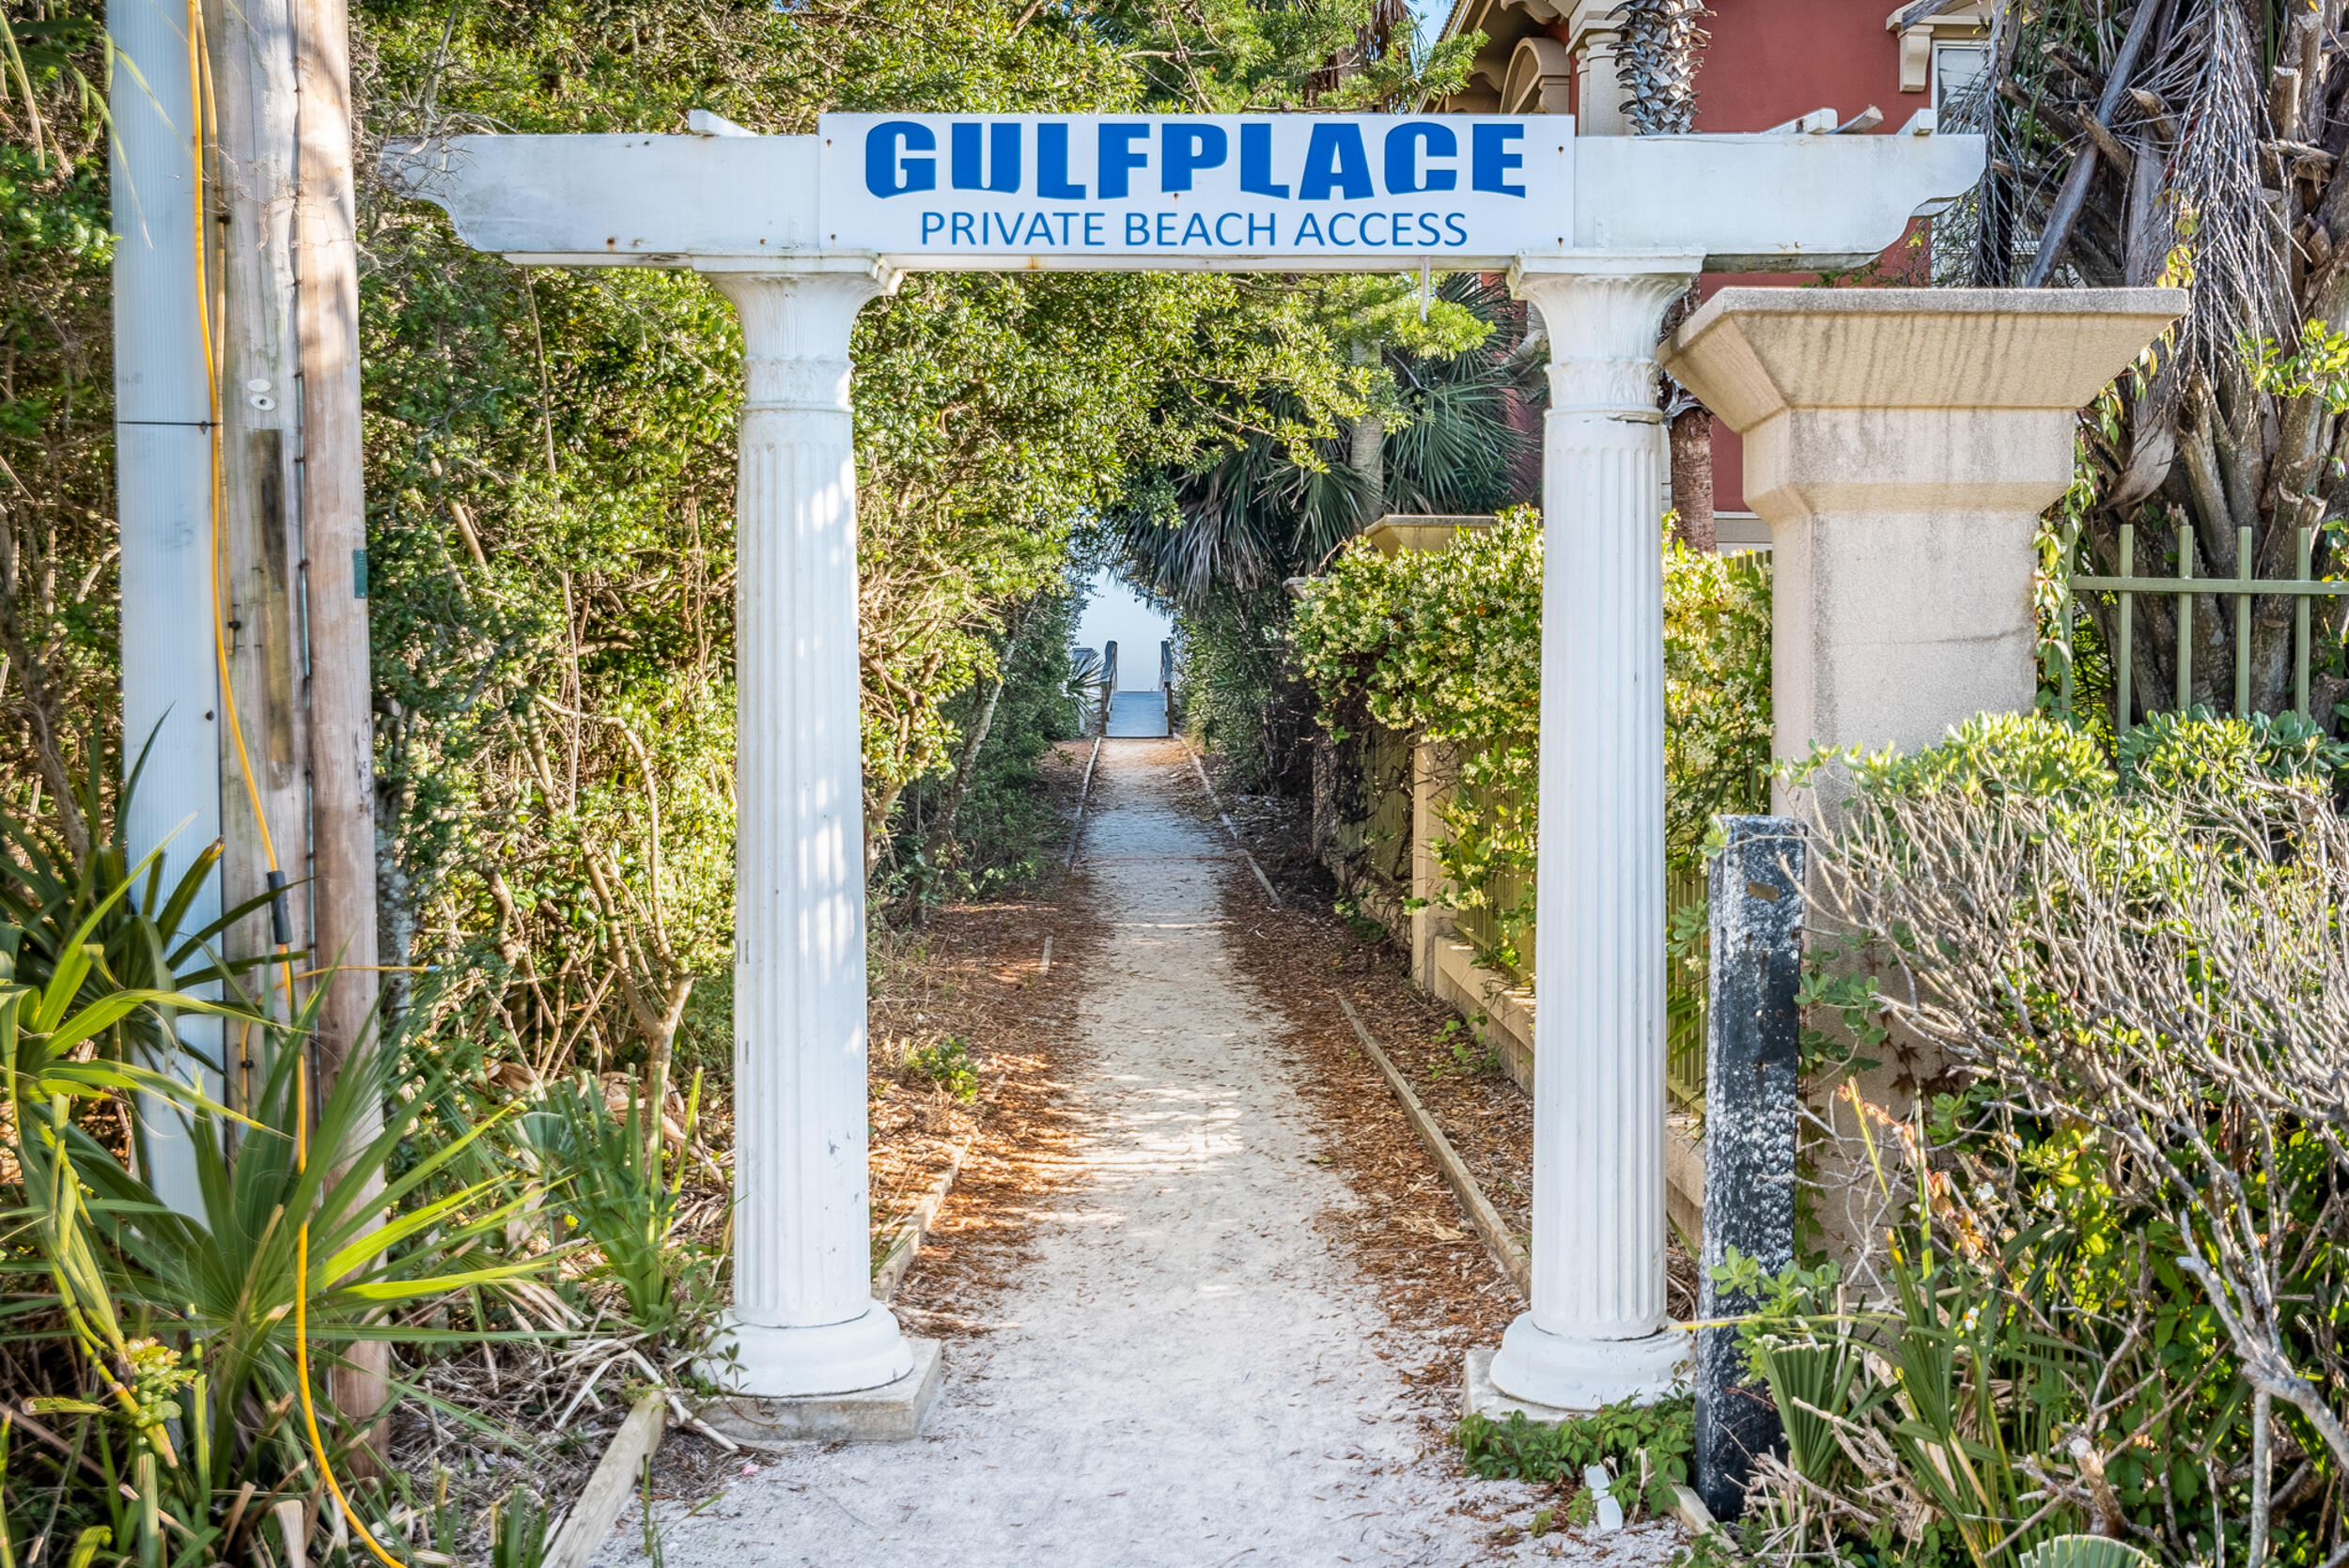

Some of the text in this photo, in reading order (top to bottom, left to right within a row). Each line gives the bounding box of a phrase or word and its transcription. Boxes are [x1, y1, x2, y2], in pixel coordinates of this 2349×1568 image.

[864, 120, 1527, 201] GULFPLACE
[921, 211, 1469, 247] PRIVATE BEACH ACCESS
